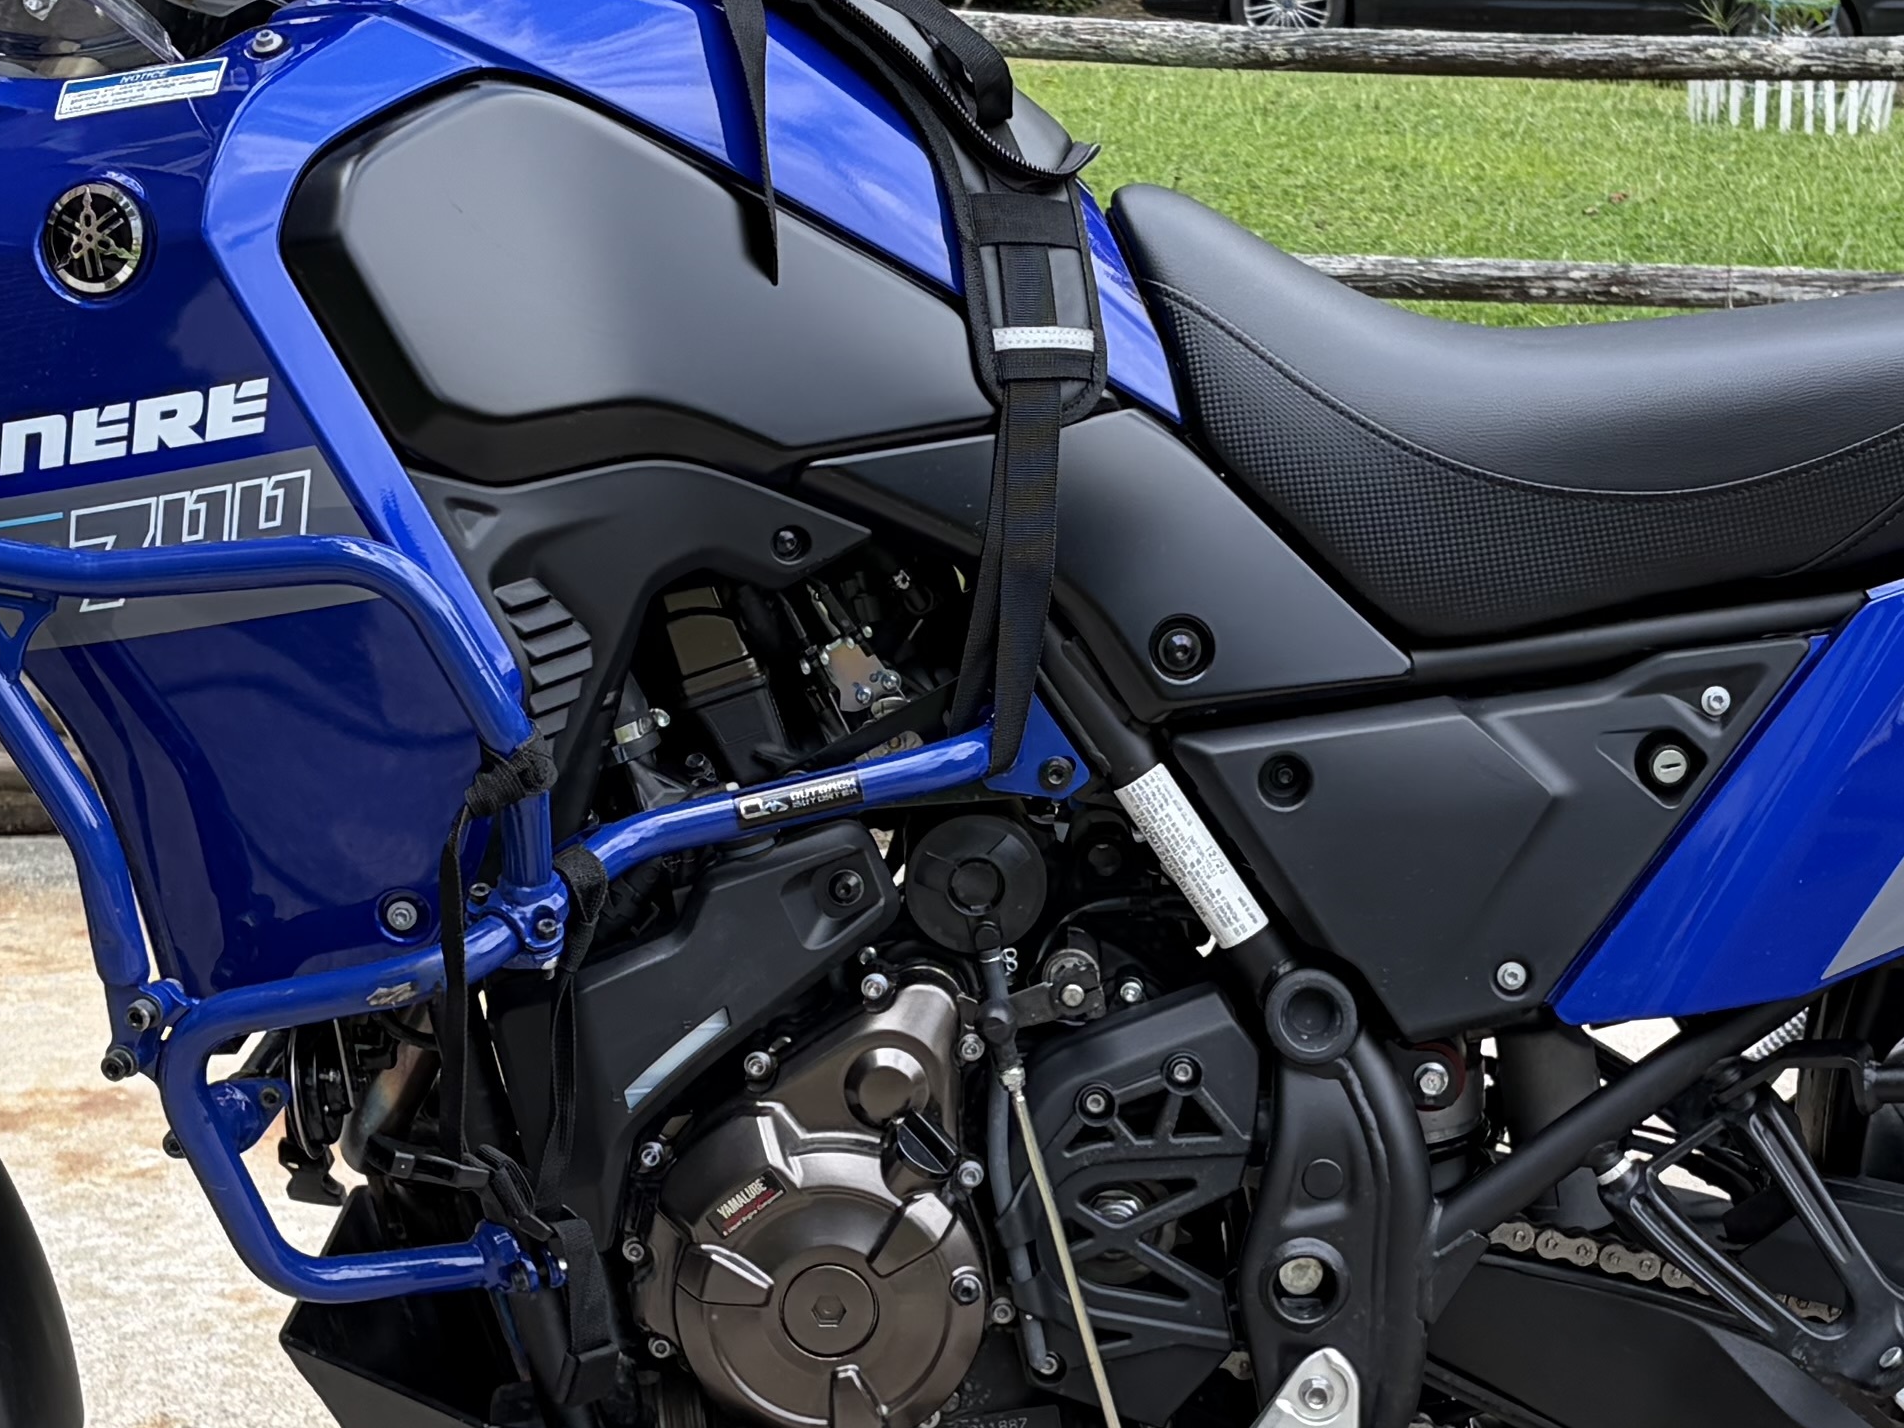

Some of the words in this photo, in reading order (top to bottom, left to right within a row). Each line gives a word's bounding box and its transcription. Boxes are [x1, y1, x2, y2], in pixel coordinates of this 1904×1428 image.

[119, 69, 170, 84] NOTICE
[1203, 843, 1229, 876] 12/23
[716, 1177, 767, 1219] YAMALUBE
